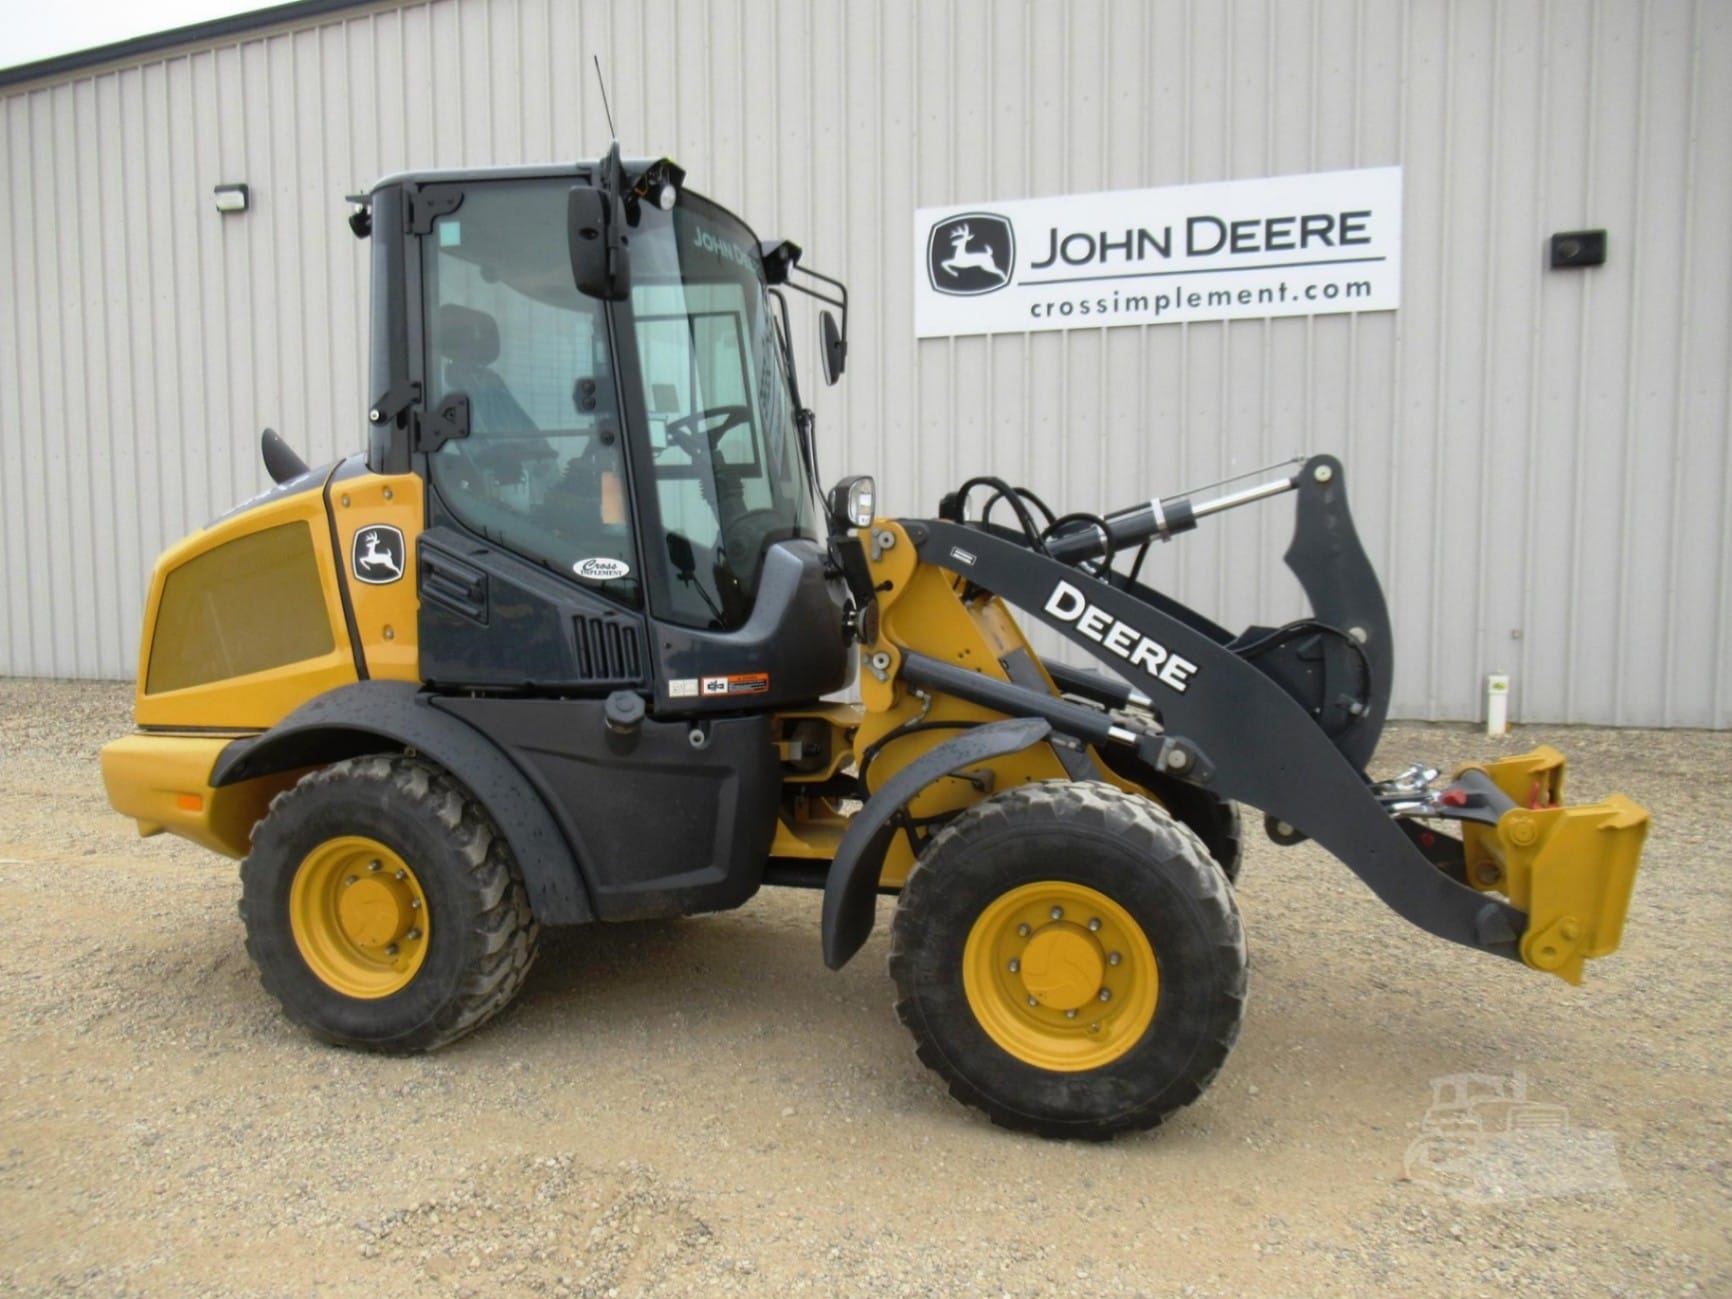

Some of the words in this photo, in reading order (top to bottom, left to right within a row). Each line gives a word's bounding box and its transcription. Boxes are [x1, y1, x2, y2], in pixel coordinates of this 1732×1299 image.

[1031, 227, 1171, 269] JOHN
[1186, 211, 1371, 257] DEERE
[1031, 281, 1371, 318] crossimplement.com
[1045, 580, 1198, 691] DEERE
